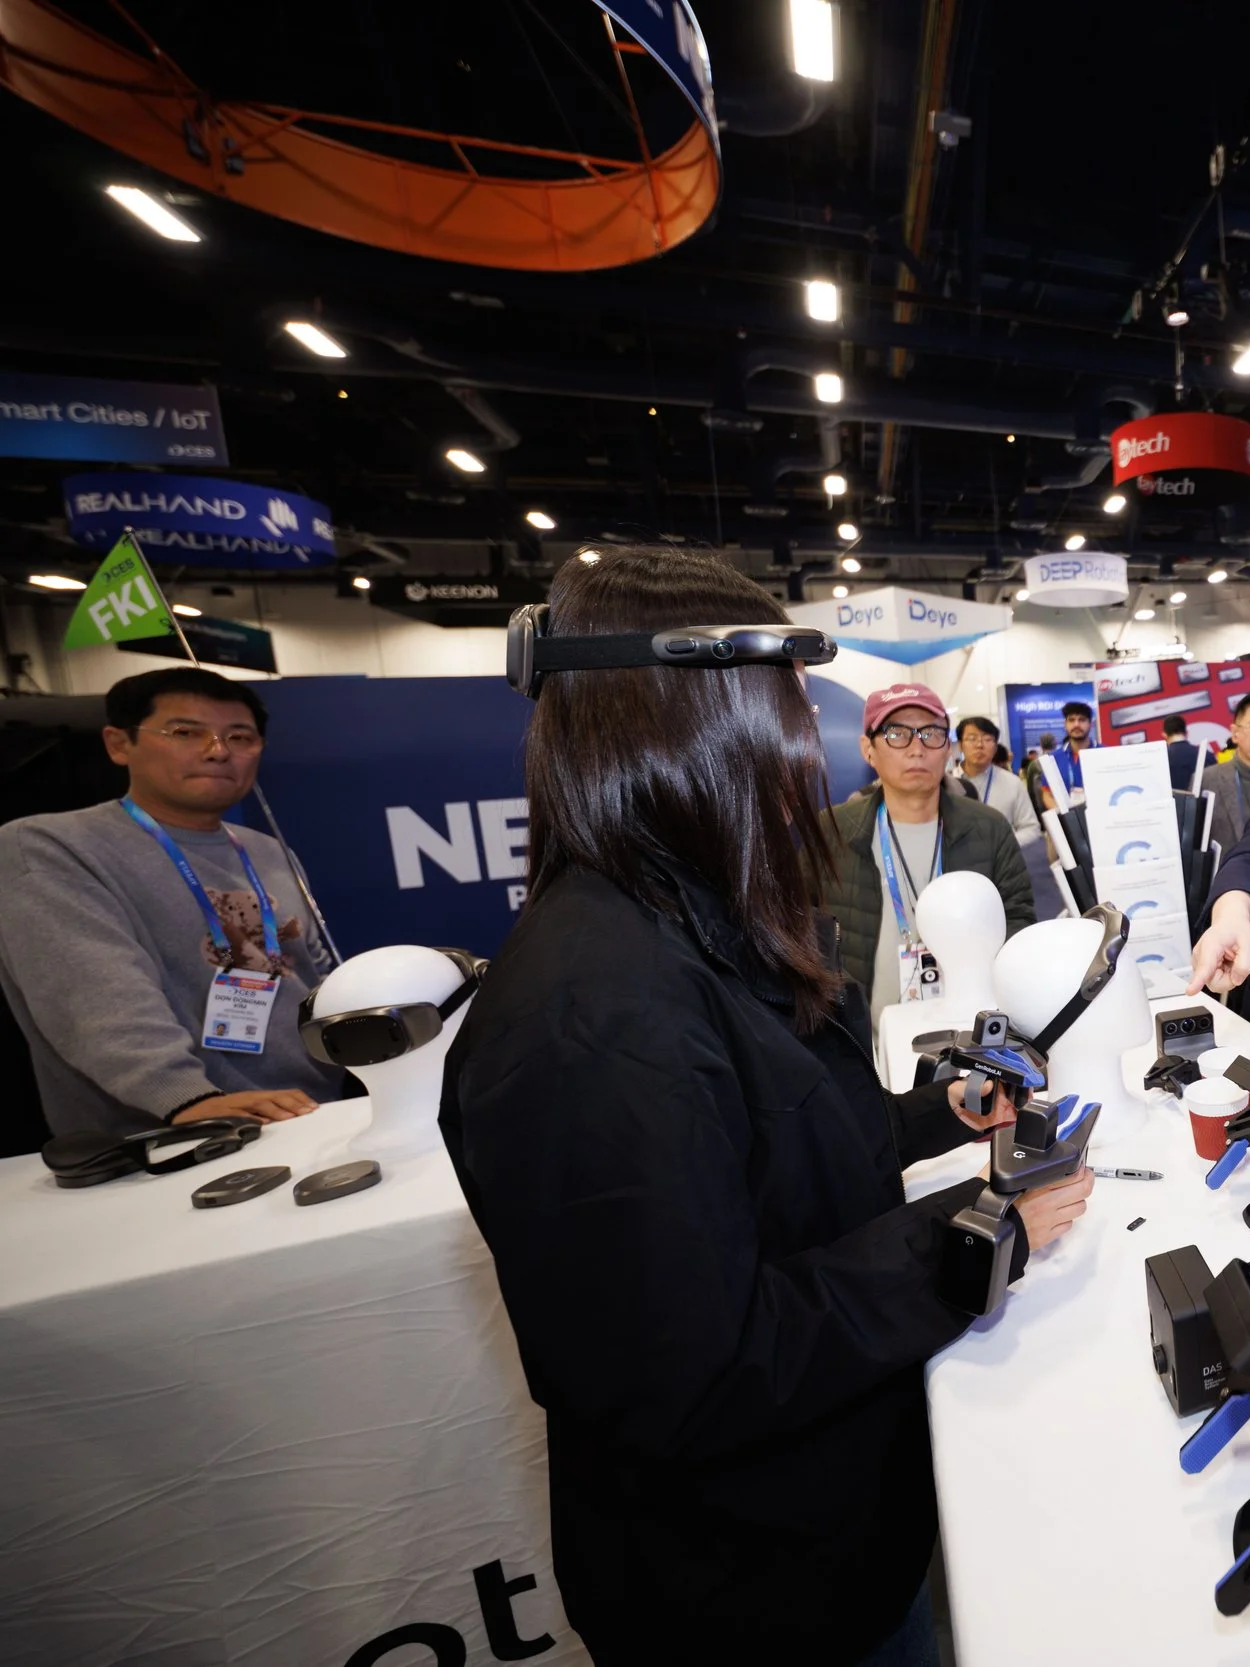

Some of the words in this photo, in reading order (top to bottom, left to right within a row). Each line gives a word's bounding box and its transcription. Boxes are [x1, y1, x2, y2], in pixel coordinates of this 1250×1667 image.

[67, 402, 149, 427] Cities
[171, 409, 211, 430] IoT
[76, 493, 246, 523] REALHAND
[430, 584, 498, 600] KEENON
[88, 575, 157, 640] FKI
[837, 604, 884, 628] Deye
[908, 598, 957, 629] Deye
[1203, 1362, 1223, 1376] DAS
